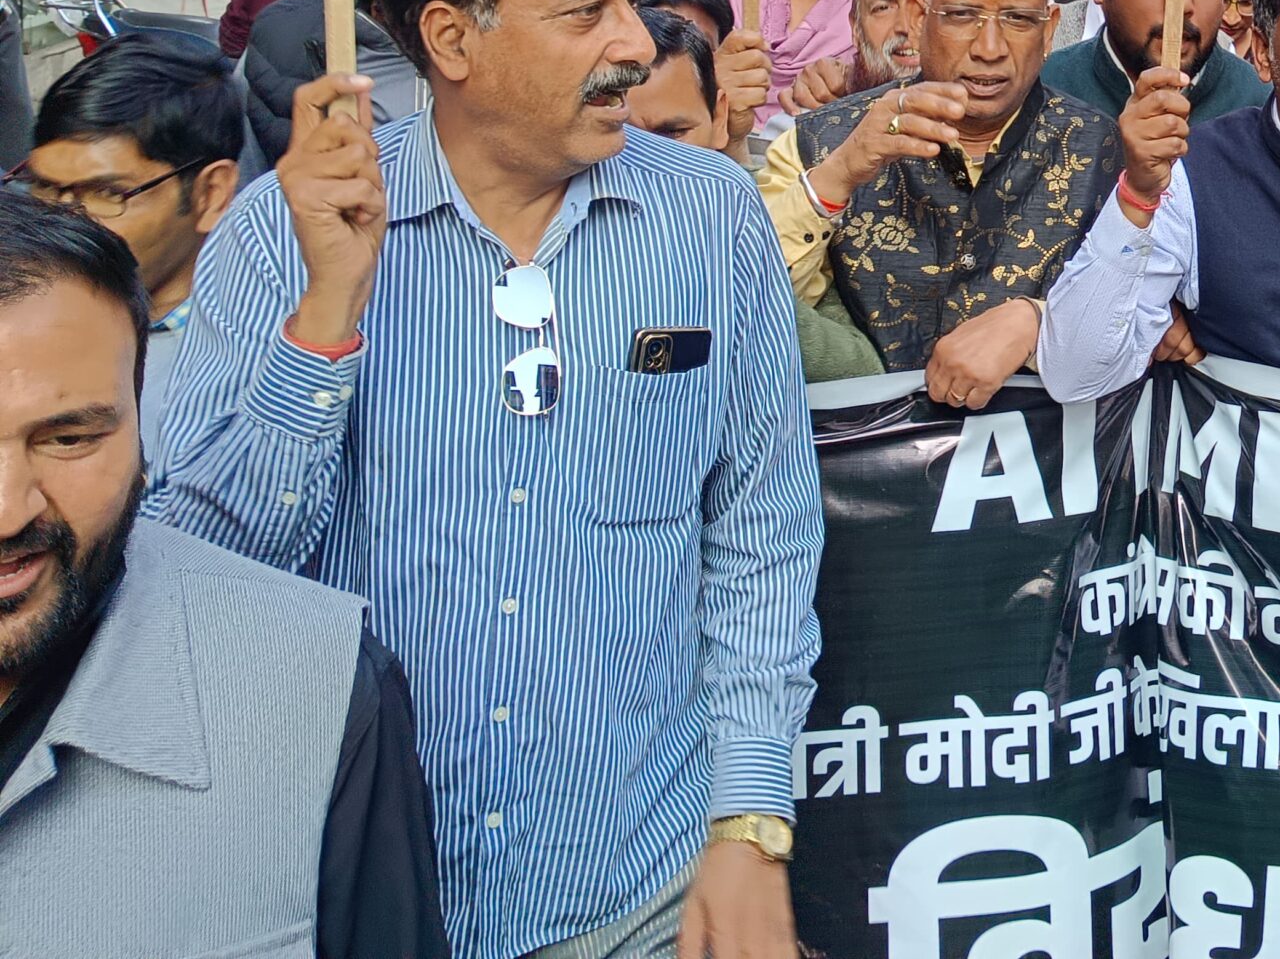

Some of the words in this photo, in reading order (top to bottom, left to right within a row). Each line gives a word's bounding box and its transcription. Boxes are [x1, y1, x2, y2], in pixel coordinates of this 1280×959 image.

[931, 403, 1100, 535] AI
[898, 689, 1056, 788] मोदी
[1060, 667, 1128, 766] जी
